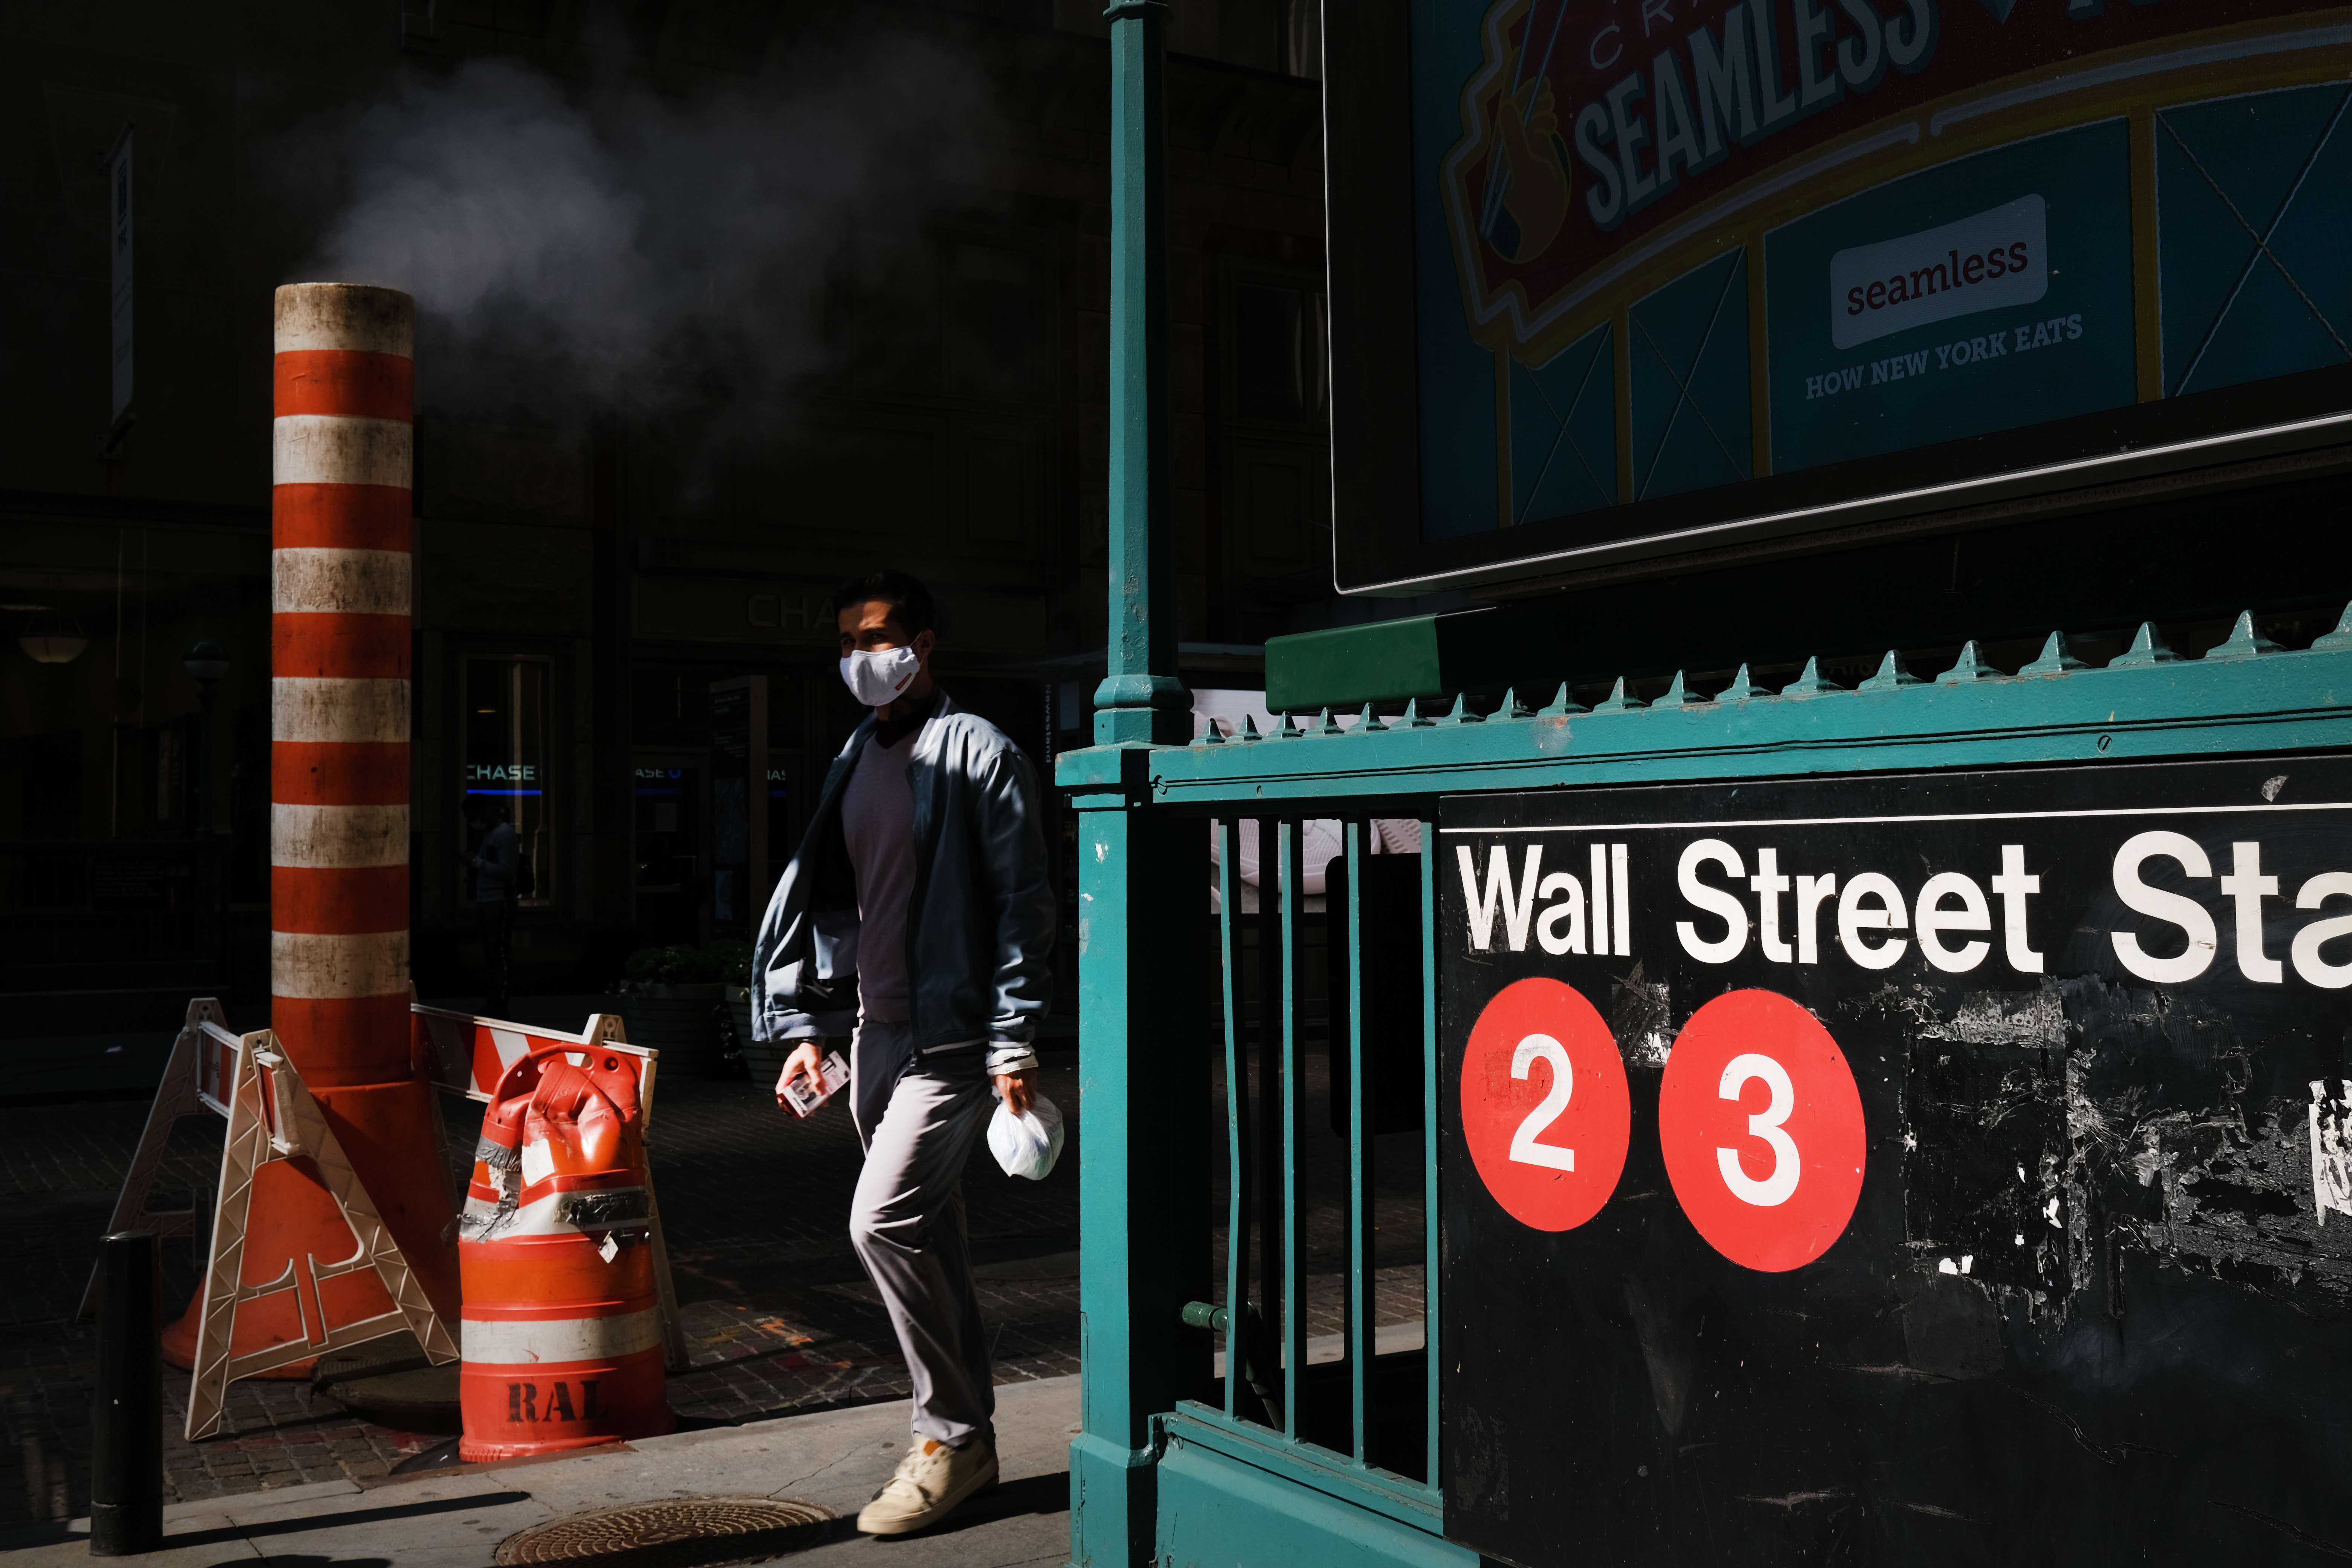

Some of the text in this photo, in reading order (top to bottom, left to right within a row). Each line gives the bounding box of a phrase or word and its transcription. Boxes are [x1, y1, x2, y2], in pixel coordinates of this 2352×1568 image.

[1590, 0, 1697, 70] CR
[1847, 242, 2028, 315] seamless
[1806, 314, 2082, 400] HOW NEW YORK EATS
[1456, 831, 2352, 989] Wall Street Sta
[1509, 1033, 1801, 1207] 2 3
